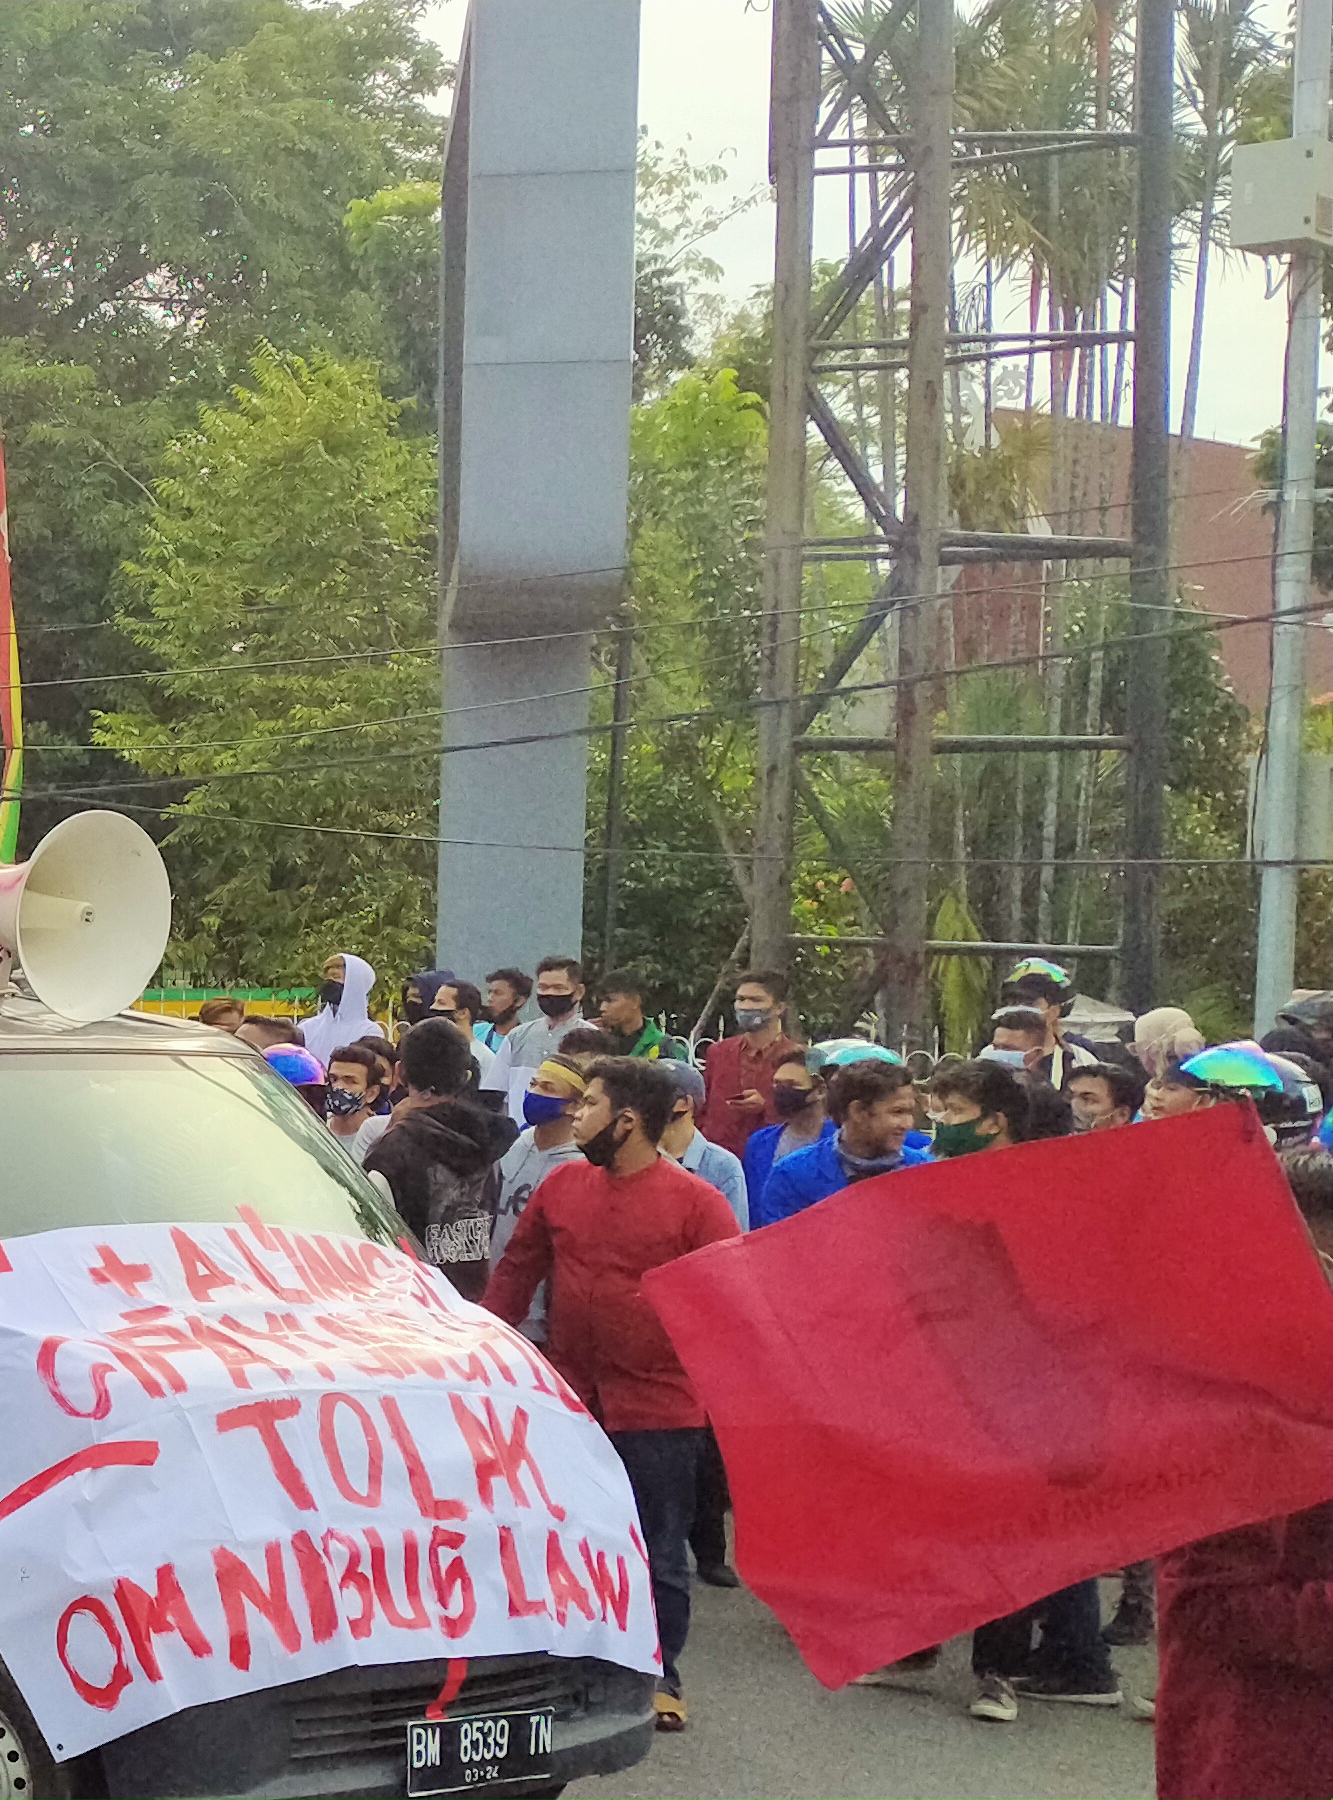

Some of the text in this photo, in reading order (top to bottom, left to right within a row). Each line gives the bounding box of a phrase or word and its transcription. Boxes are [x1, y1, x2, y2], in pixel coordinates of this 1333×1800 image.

[215, 1390, 566, 1523] TOLAK
[56, 1524, 477, 1712] OMNIBUS
[412, 1714, 553, 1769] BM 8539 TN
